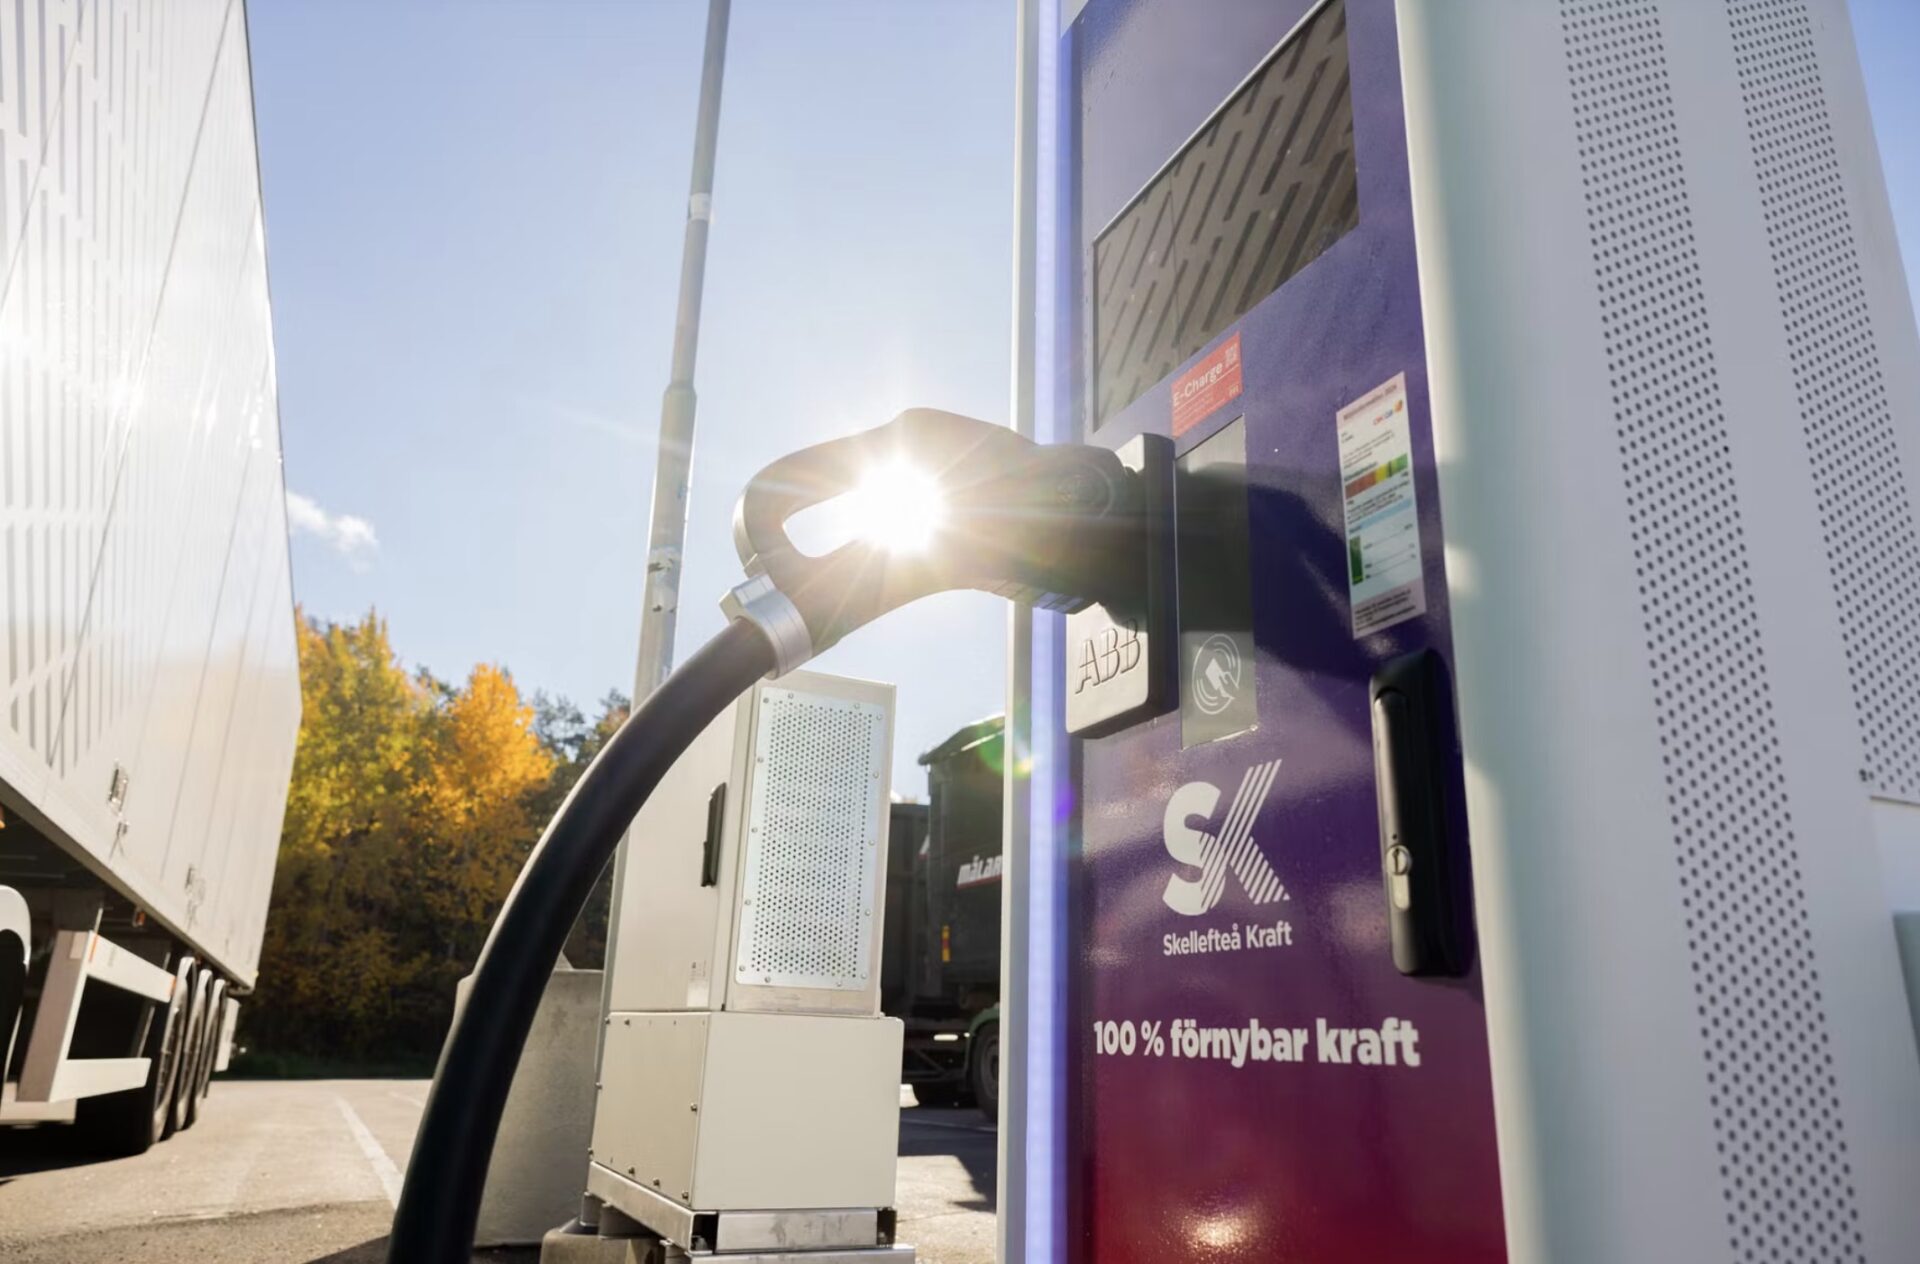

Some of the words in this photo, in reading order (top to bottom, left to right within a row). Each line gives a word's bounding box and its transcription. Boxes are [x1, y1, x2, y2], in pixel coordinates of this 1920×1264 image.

[1173, 362, 1223, 407] E-Charge
[1075, 618, 1141, 694] ABB
[1162, 759, 1291, 916] SK
[1163, 923, 1241, 956] Skellefteå
[1246, 920, 1293, 949] Kraft
[1093, 1020, 1137, 1056] 100
[1141, 1020, 1165, 1057] %
[1170, 1018, 1309, 1069] förnybar
[1316, 1017, 1421, 1067] kraft
